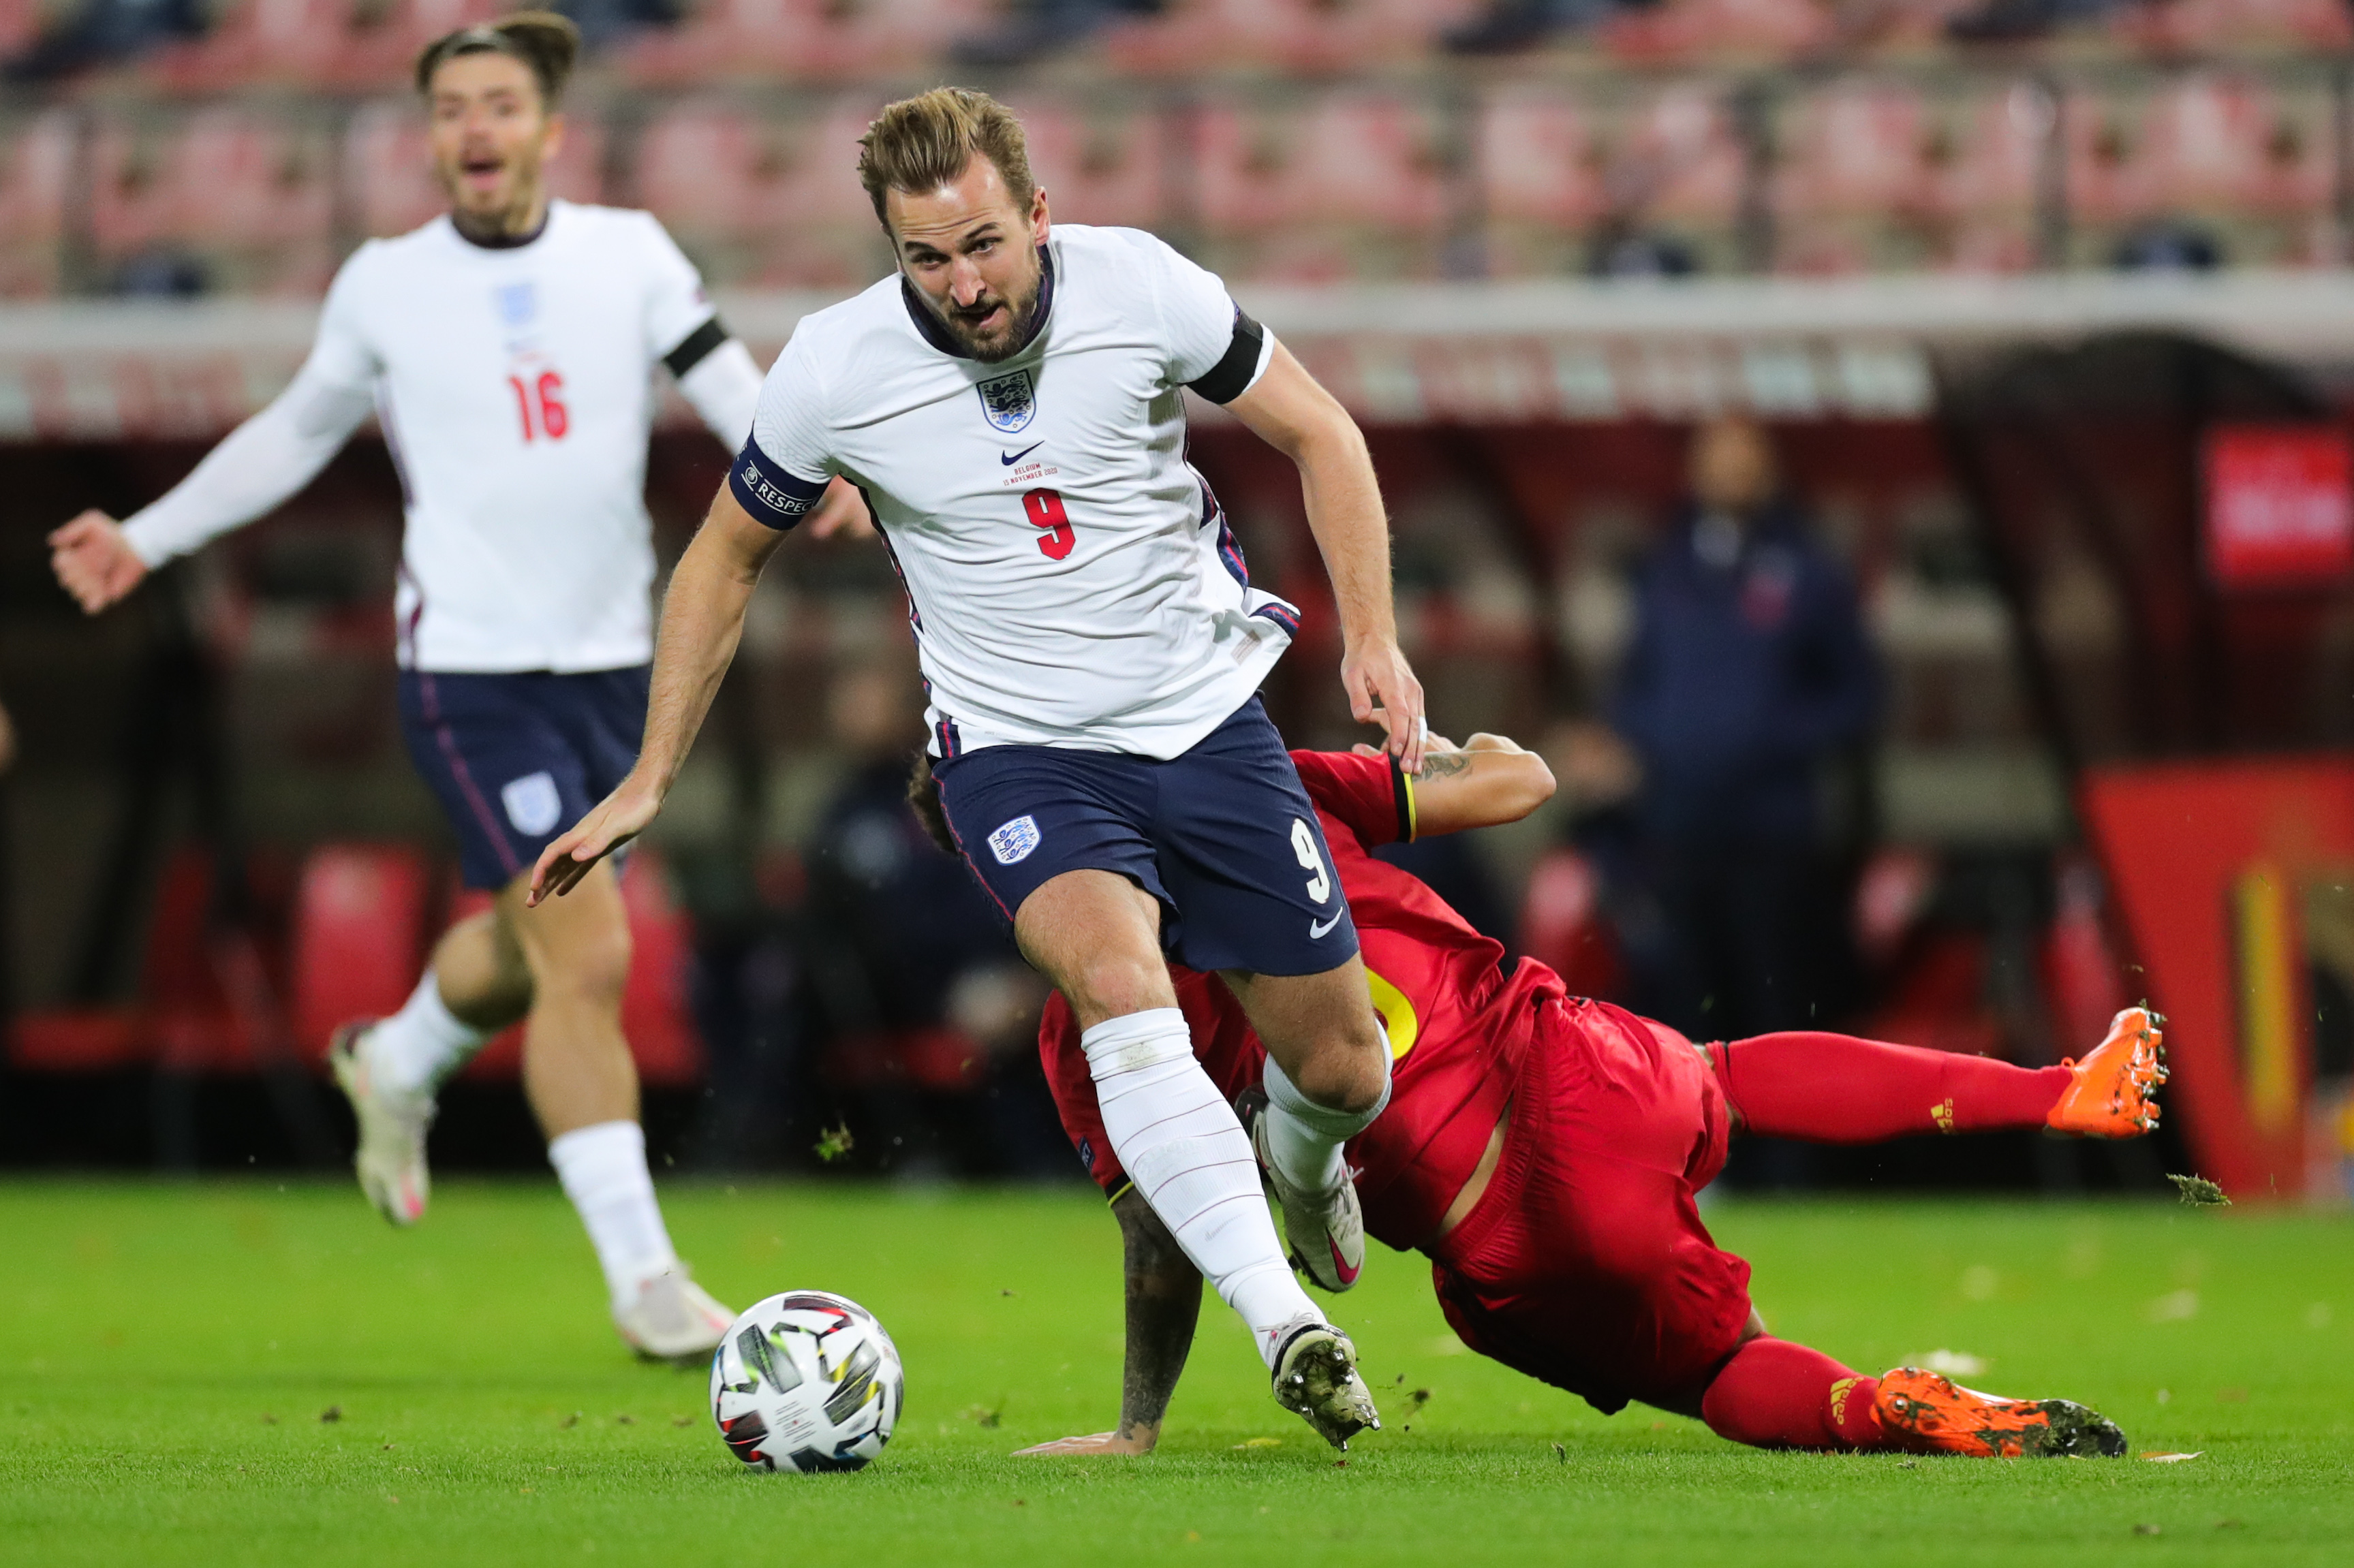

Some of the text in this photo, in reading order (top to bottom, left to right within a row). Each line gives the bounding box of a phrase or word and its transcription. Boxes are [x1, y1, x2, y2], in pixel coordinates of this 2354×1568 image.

[508, 372, 568, 441] 16
[1010, 470, 1043, 484] NOVEMBER
[1014, 463, 1041, 475] BELGIUM
[1022, 487, 1076, 561] 9
[1290, 818, 1330, 905] 9
